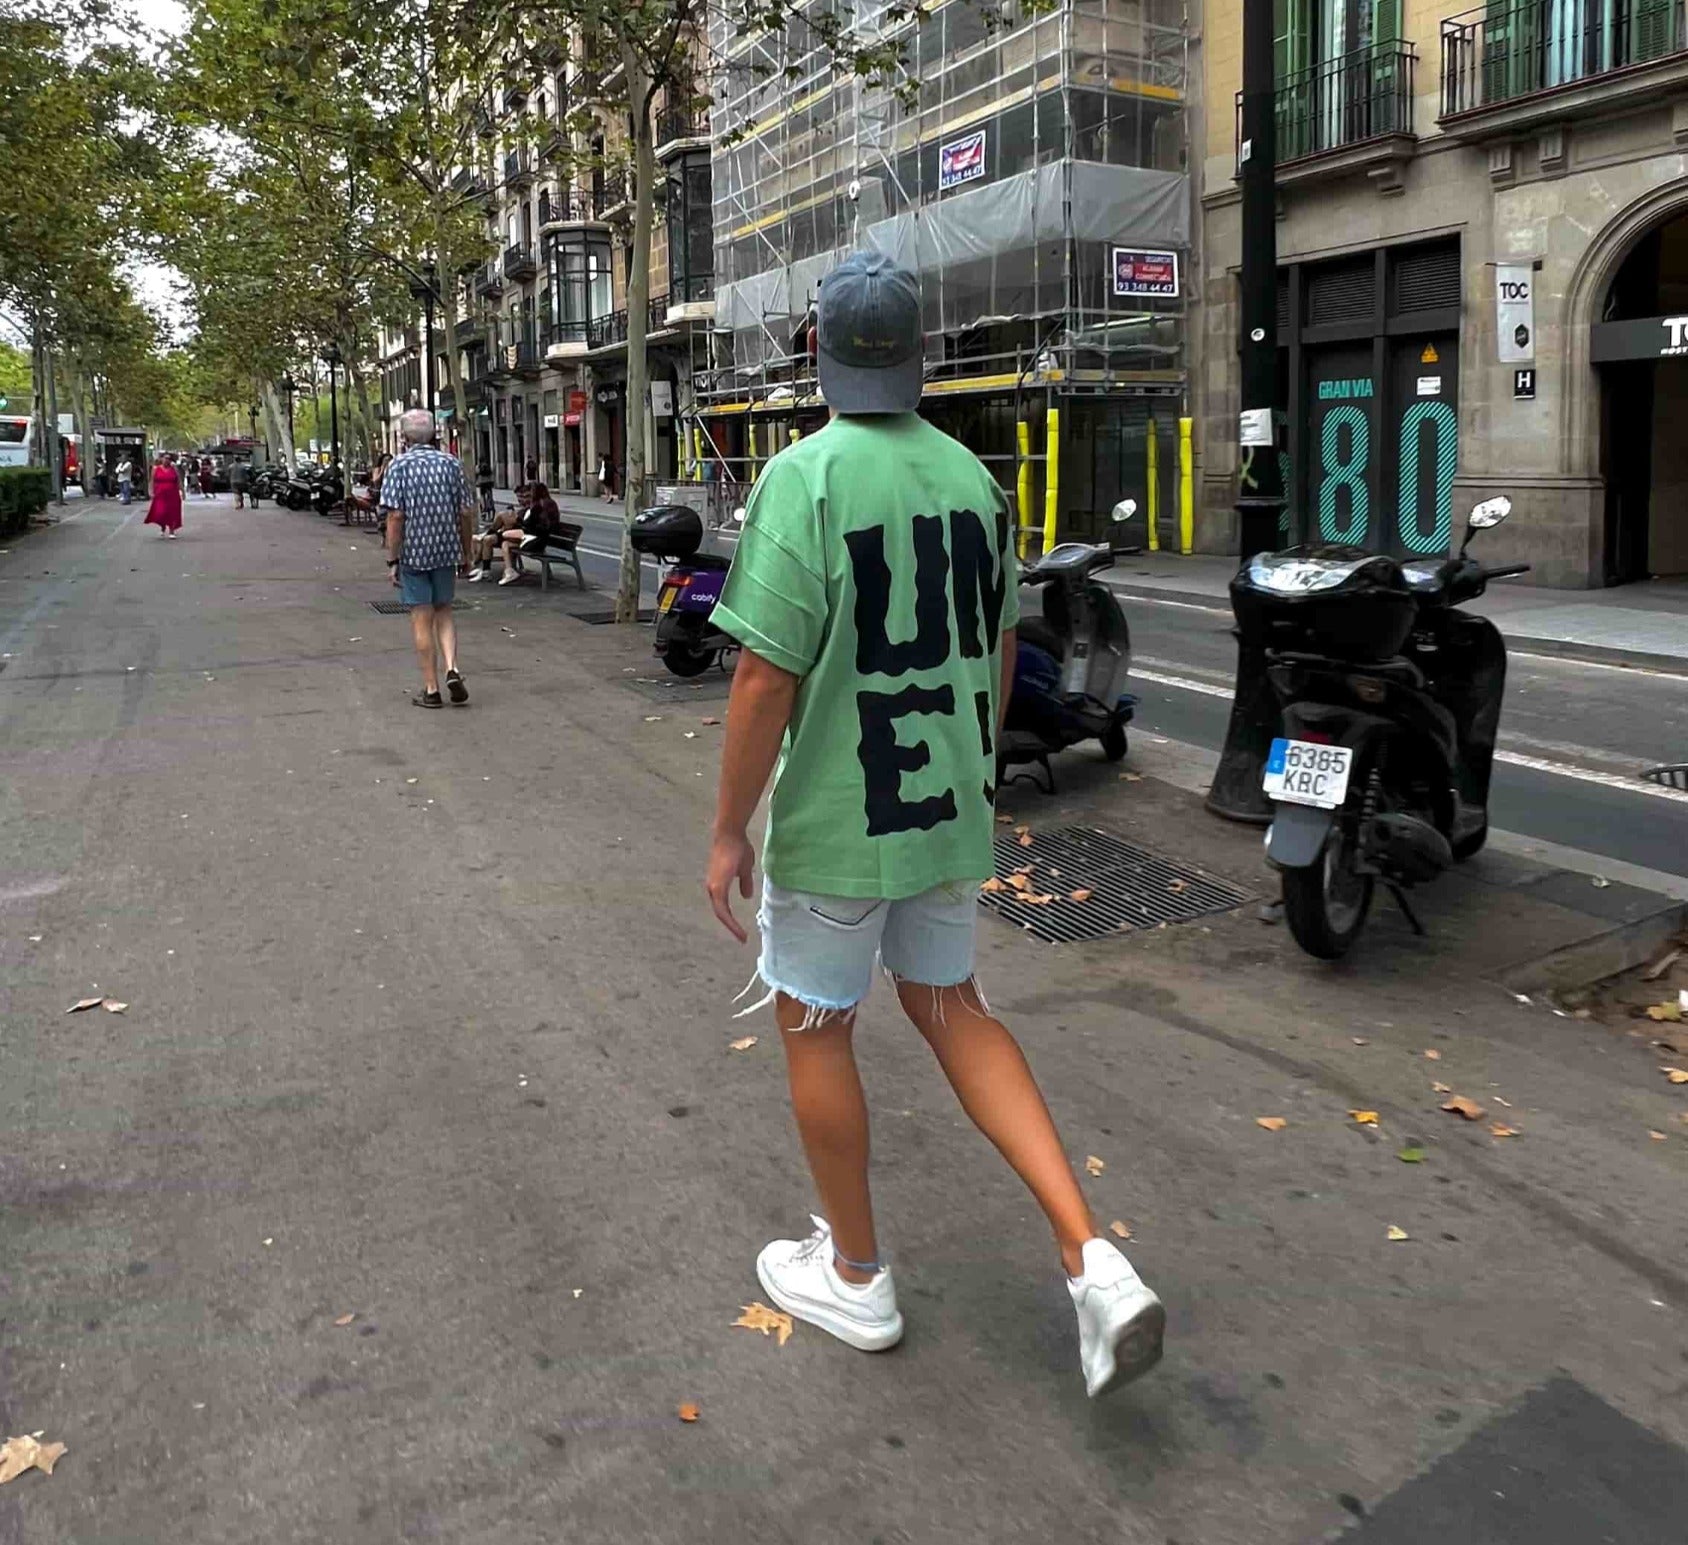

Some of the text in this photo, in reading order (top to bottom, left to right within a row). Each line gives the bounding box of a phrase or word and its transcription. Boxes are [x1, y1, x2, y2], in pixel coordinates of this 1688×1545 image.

[1499, 282, 1529, 299] TOC
[1517, 371, 1531, 388] H
[1318, 378, 1374, 399] GRAN VIA
[691, 593, 716, 605] cabify
[1286, 746, 1347, 775] 6385
